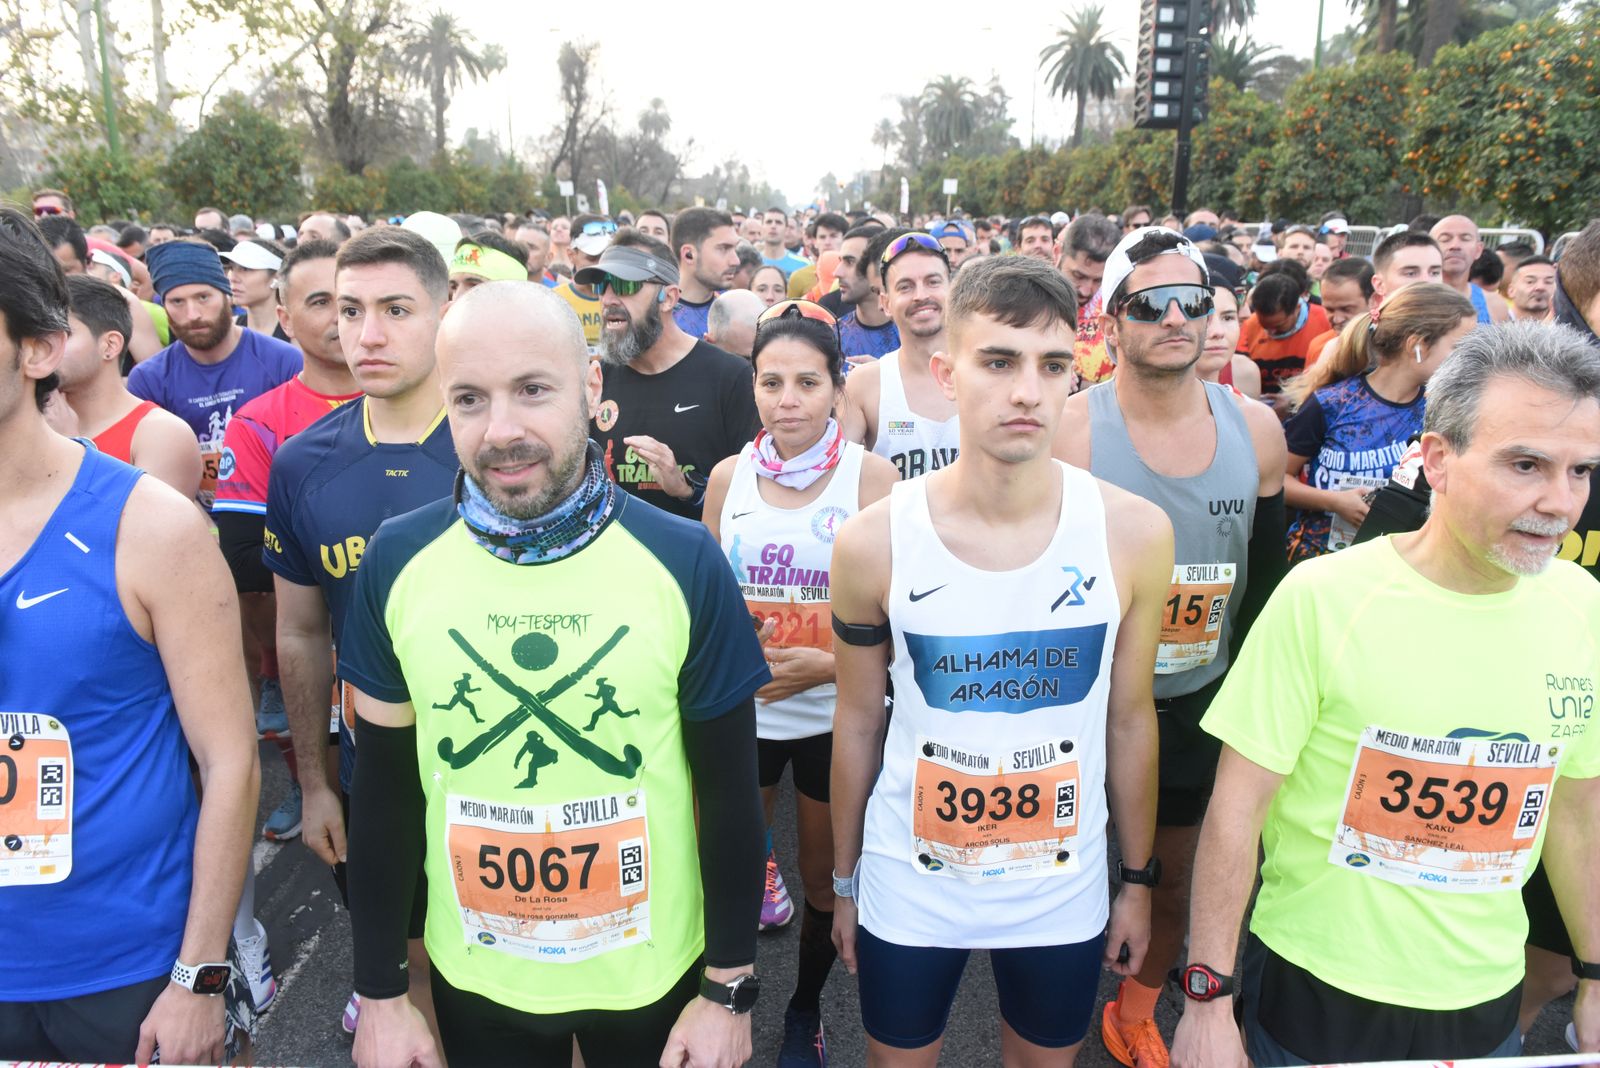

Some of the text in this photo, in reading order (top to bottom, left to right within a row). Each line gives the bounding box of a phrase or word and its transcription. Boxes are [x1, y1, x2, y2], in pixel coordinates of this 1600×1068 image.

[578, 312, 601, 326] NA
[385, 469, 409, 477] TACTIC
[1209, 499, 1244, 515] UVU
[321, 535, 374, 579] UB
[761, 543, 794, 568] GQ
[1186, 566, 1219, 581] SEVILLA
[757, 587, 785, 598] MARATÓN
[1166, 594, 1204, 625] 15
[933, 647, 1079, 674] ALHAMA DE
[950, 674, 1060, 702] ARAGÓN
[1376, 729, 1461, 756] MEDIO MARATÓN
[951, 749, 990, 769] MARATÓN
[1013, 743, 1056, 769] SEVILLA
[1487, 743, 1541, 763] SEVILLA
[936, 781, 1040, 824] 3938
[1379, 770, 1509, 826] 3539
[460, 800, 534, 825] MEDIO MARATÓN
[563, 796, 619, 826] SEVILLA
[977, 824, 997, 832] IKER
[1425, 823, 1455, 833] KAKU
[1404, 835, 1444, 847] SANCHEZ
[479, 843, 600, 893] 5067
[982, 867, 1006, 877] HOKA
[1418, 872, 1448, 883] HOKA
[539, 946, 566, 955] HOKA
